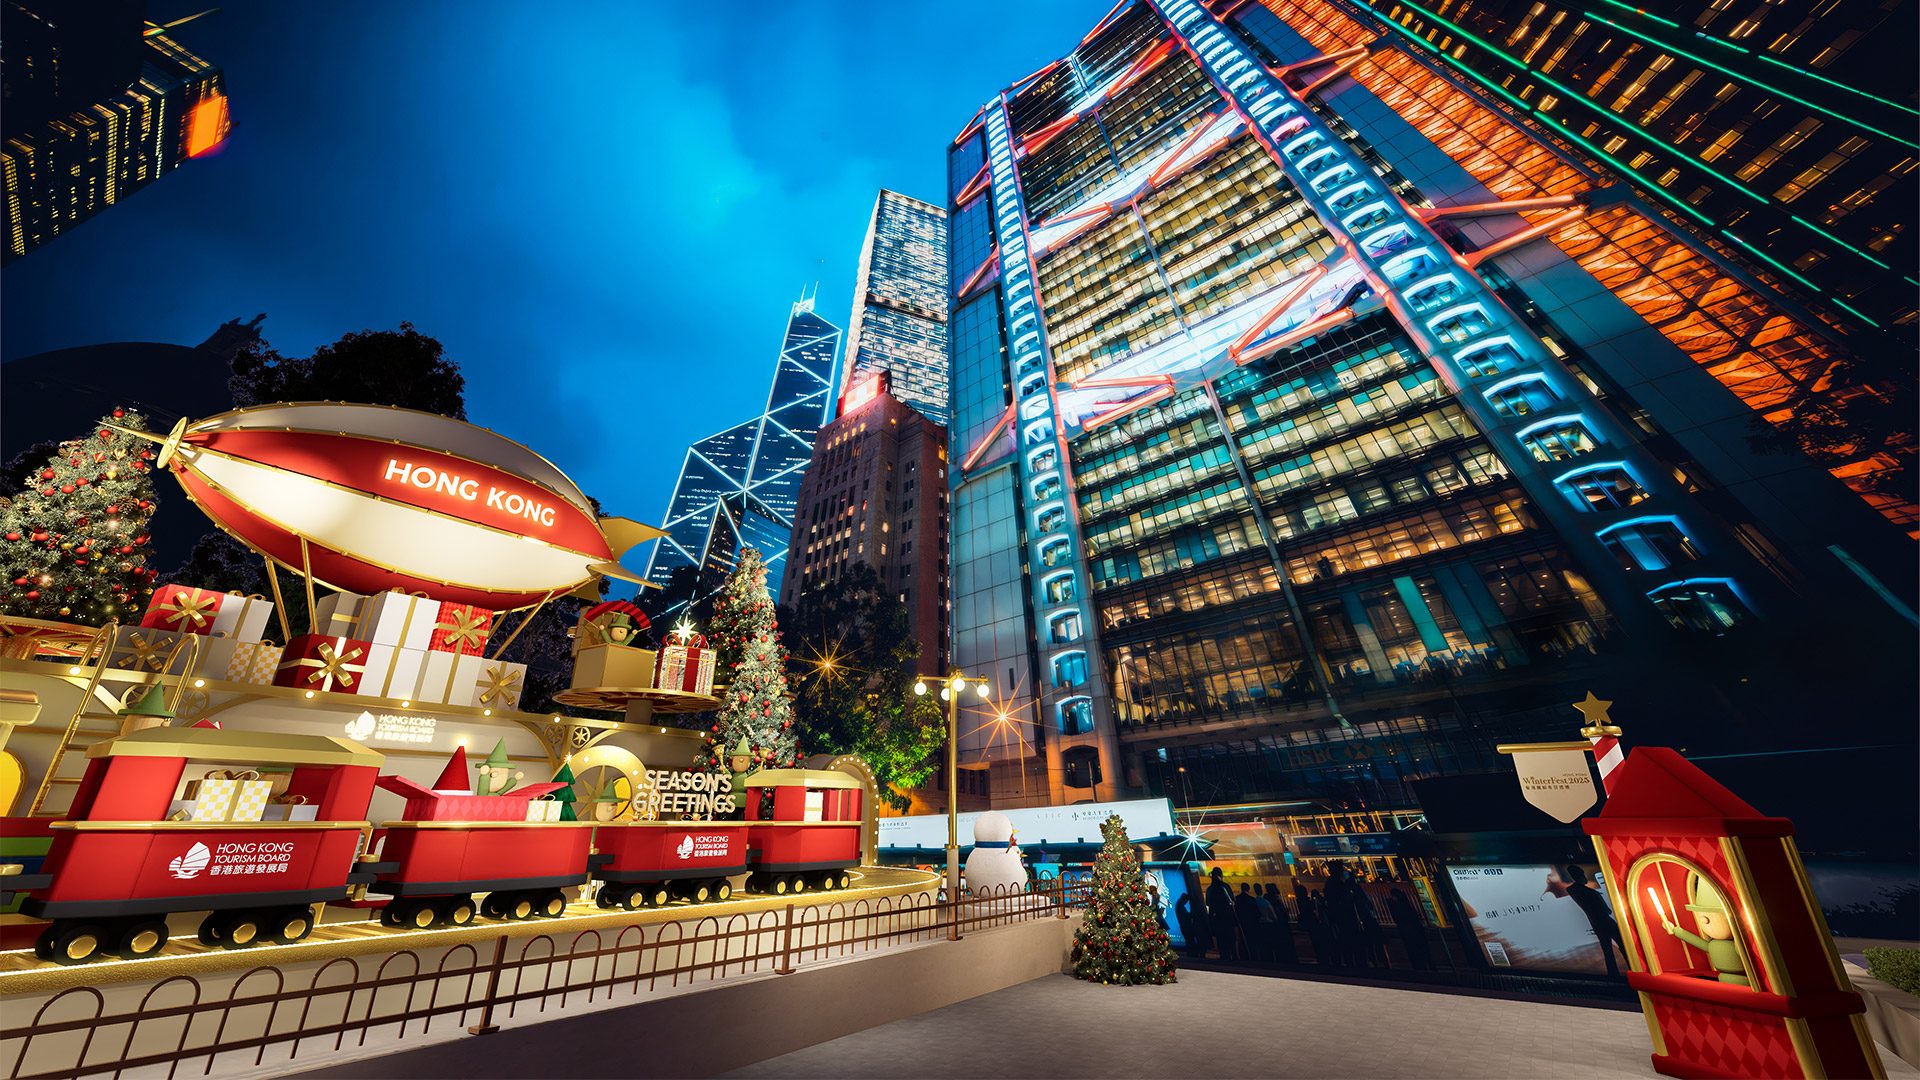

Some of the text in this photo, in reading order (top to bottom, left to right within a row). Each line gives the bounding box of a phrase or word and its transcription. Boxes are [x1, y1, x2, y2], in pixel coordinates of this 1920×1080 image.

[384, 459, 556, 527] HONG KONG
[379, 714, 437, 727] HONG KONG
[643, 769, 733, 793] SEASON'S
[1522, 776, 1568, 785] WinterFest
[632, 791, 737, 814] GREETINGS
[216, 842, 294, 854] HONG KONG
[214, 853, 291, 864] TOURISM BOARD
[210, 863, 289, 876] 香港旅遊發展局
